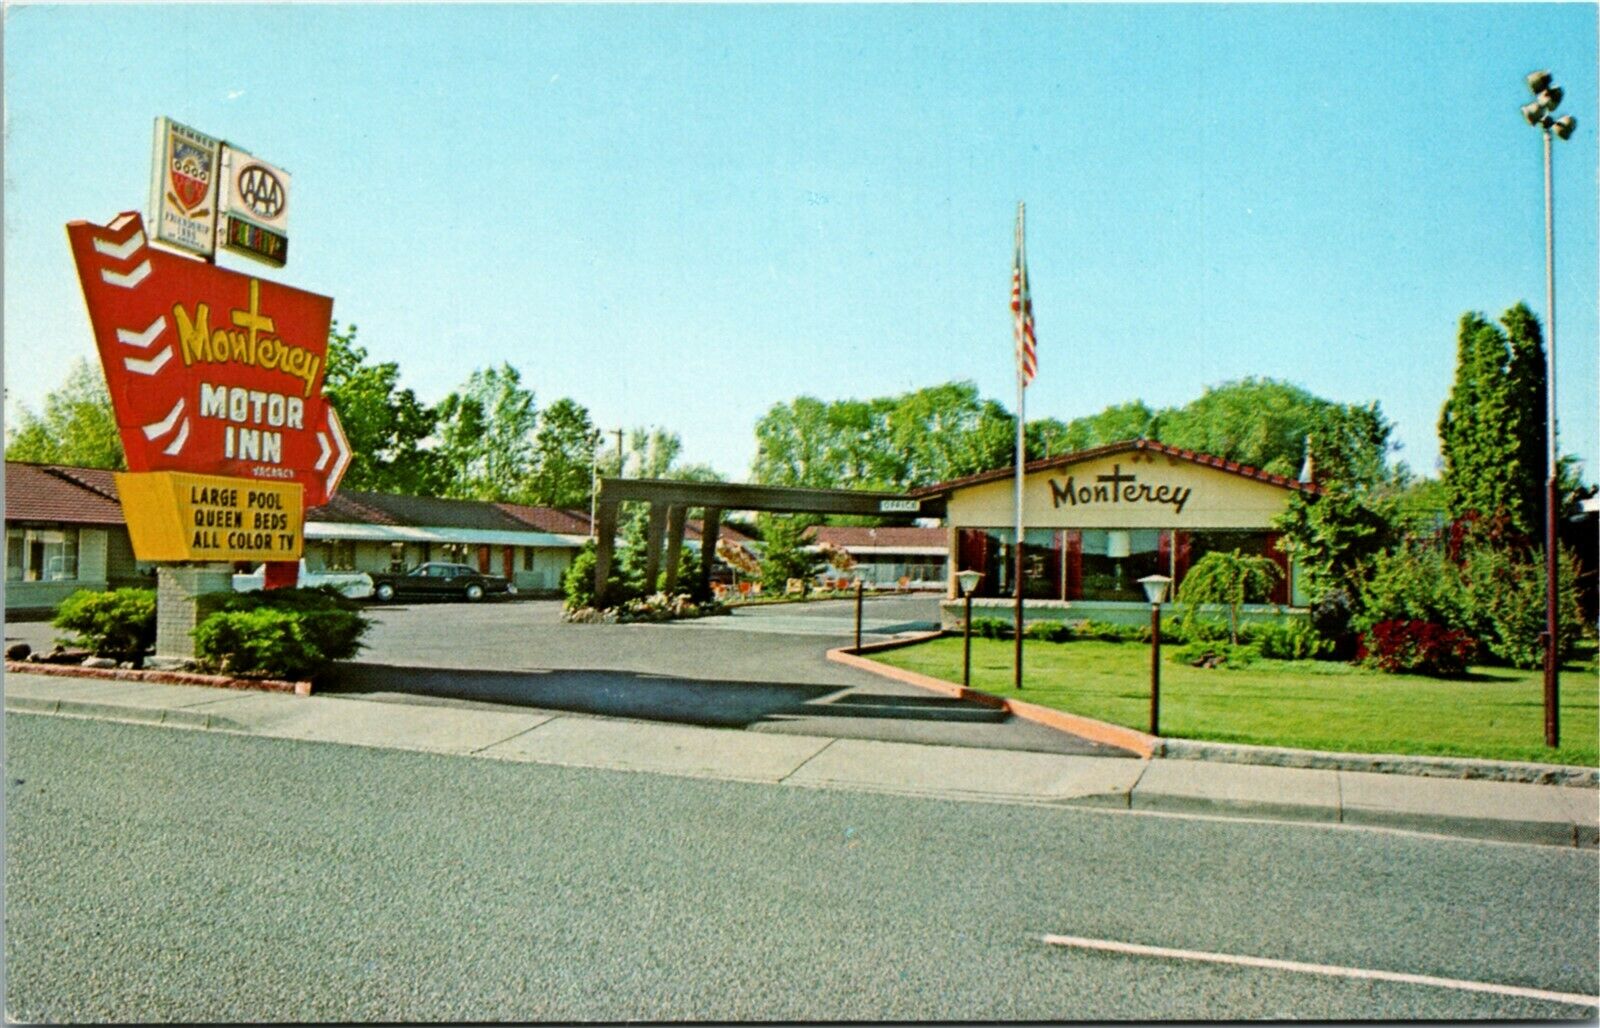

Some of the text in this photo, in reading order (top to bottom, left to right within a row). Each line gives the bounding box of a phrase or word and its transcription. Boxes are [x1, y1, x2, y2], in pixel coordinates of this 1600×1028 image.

[171, 123, 214, 148] MEMBER
[240, 166, 284, 217] AAA
[173, 278, 320, 397] Monterey
[200, 383, 304, 430] MOTOR
[225, 425, 282, 464] INN
[252, 465, 295, 478] VACANCY
[191, 486, 283, 510] LARGE POOL
[1048, 463, 1192, 514] Monterey
[884, 500, 916, 510] OFFICE
[194, 509, 288, 531] QUEEN BEDS
[192, 531, 295, 551] ALL COLOR TV
